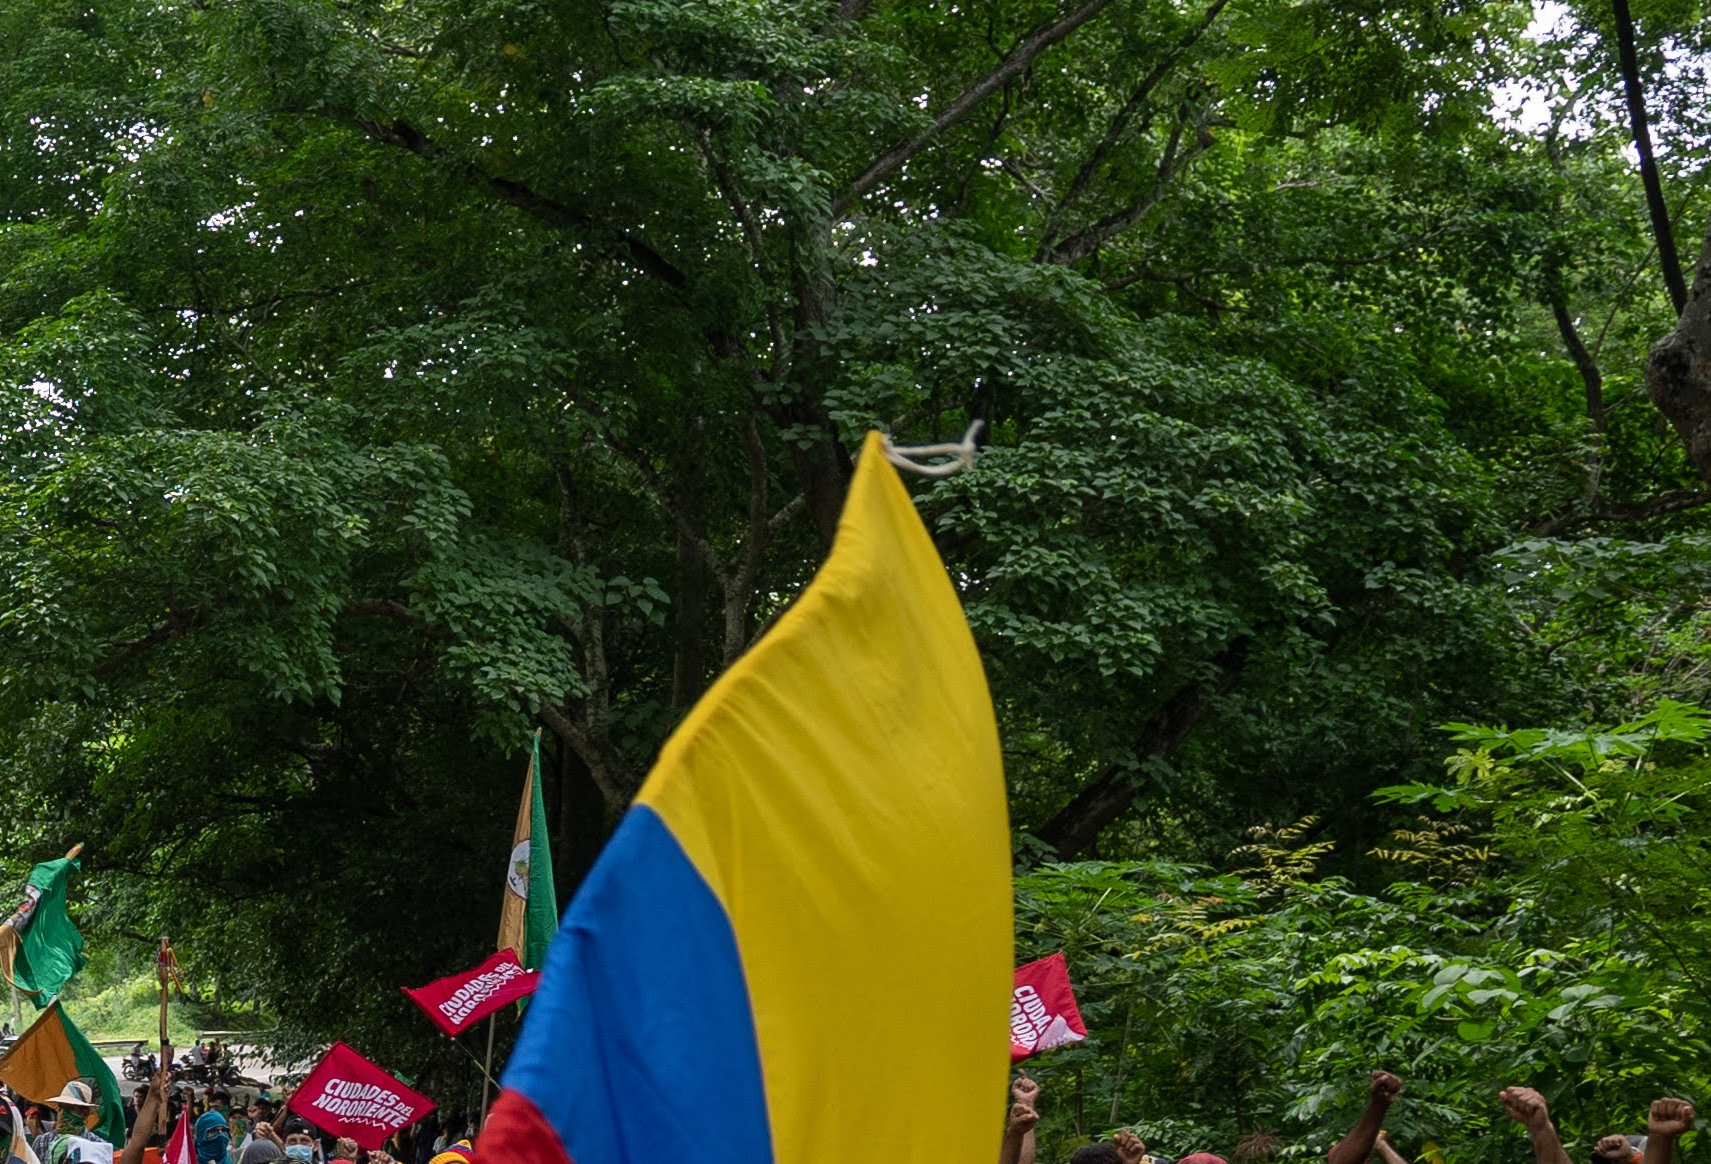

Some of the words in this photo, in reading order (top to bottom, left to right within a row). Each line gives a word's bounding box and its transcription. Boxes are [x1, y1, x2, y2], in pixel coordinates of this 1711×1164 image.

[1014, 985, 1052, 1036] CIUDA
[311, 1093, 410, 1129] NORORIENTE
[324, 1078, 401, 1107] CIUDADES
[393, 1101, 415, 1117] DEL
